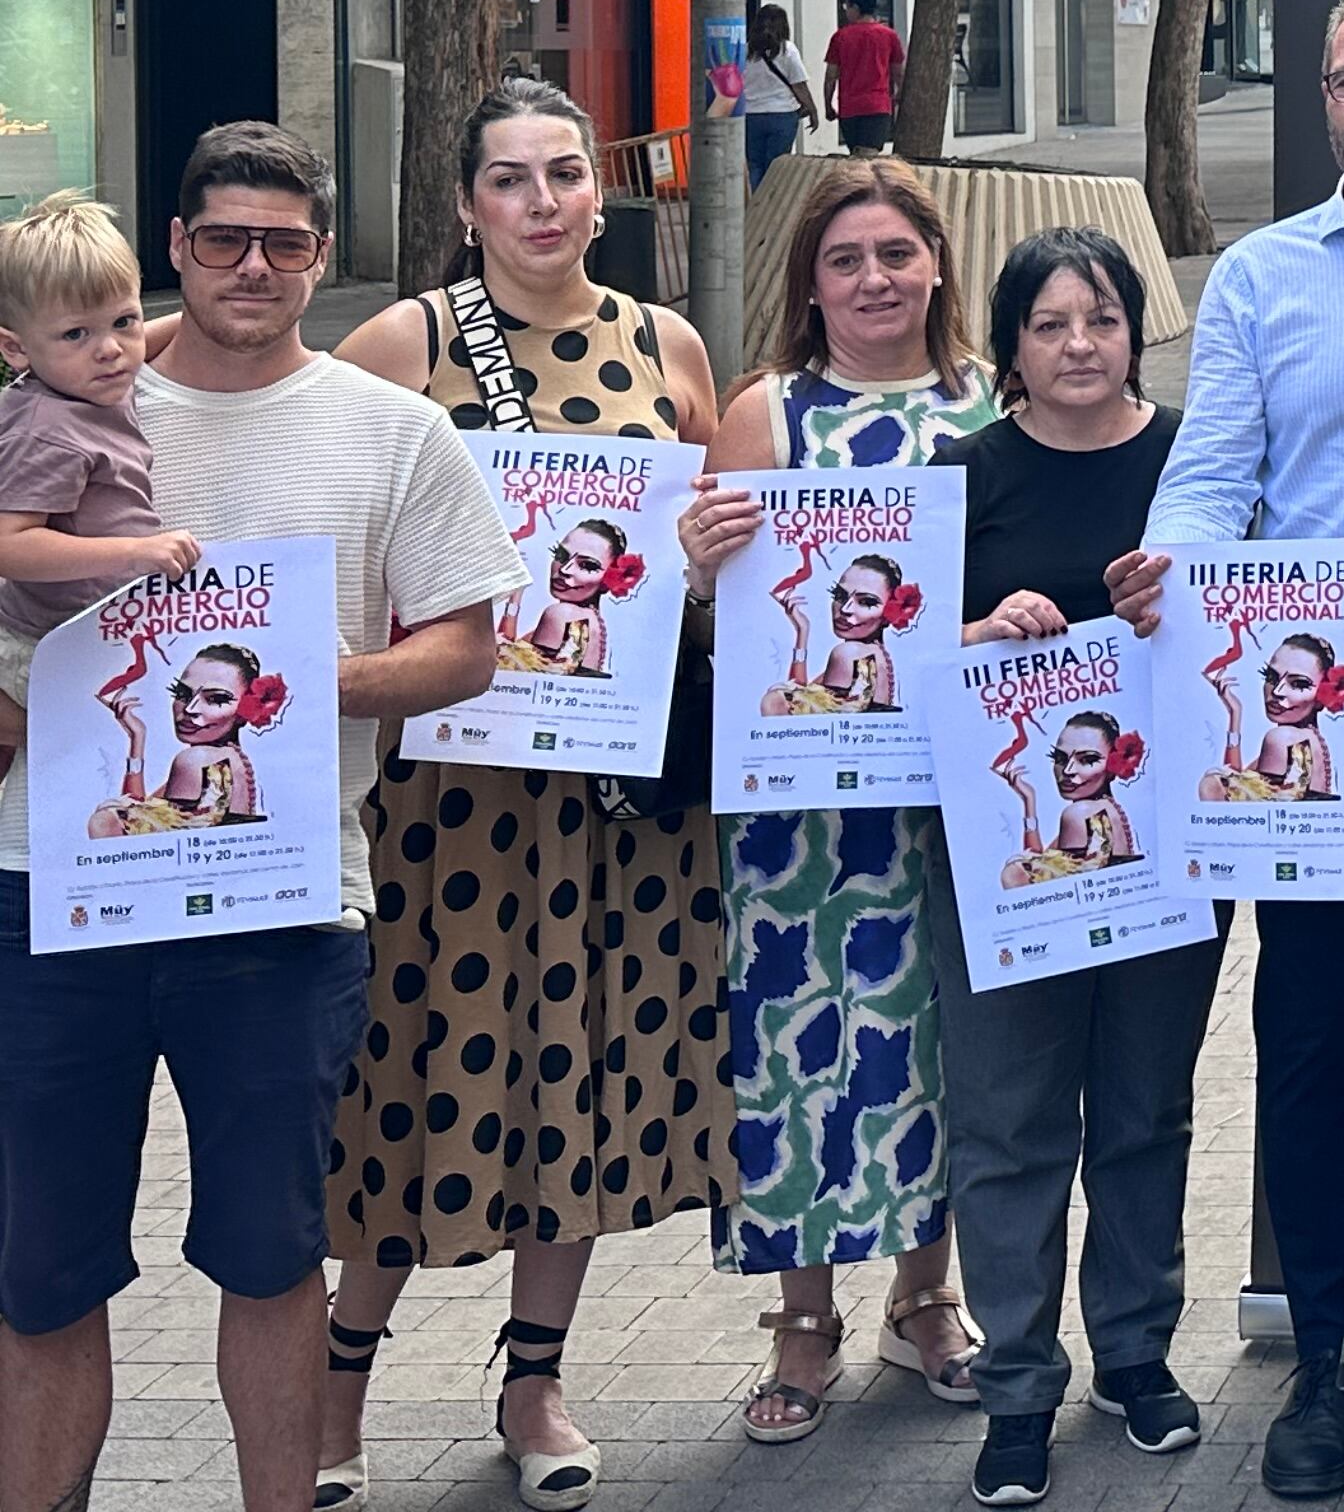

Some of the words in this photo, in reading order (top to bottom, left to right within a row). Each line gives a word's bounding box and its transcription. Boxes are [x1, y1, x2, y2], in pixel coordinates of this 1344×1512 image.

[492, 446, 521, 467] III
[530, 450, 611, 474] FERIA
[619, 456, 654, 478] DE
[504, 467, 646, 496] COMERCIO
[503, 487, 642, 512] TRADICIONAL
[798, 489, 876, 508] FERIA
[886, 488, 917, 507] DE
[775, 508, 912, 528] COMERCIO
[774, 528, 912, 544] TRADICIONAL
[237, 563, 275, 588] DE
[1190, 564, 1215, 586] III
[1227, 562, 1306, 584] FERIA
[1203, 583, 1344, 605] COMERCIO
[98, 587, 270, 622] COMERCIO
[1204, 605, 1344, 623] TRADICIONAL
[98, 611, 271, 640] TRADICIONAL
[963, 664, 991, 689] III
[1000, 645, 1080, 681] FERIA
[1087, 636, 1121, 662] DE
[542, 681, 554, 691] 18
[980, 657, 1120, 704] COMERCIO
[540, 695, 551, 704] 19
[554, 697, 562, 706] y
[564, 697, 577, 707] 20
[983, 678, 1123, 720] TRADICIONAL
[752, 729, 765, 739] En
[767, 728, 829, 740] septiembre
[839, 721, 850, 730] 18
[839, 735, 849, 744] 19
[852, 736, 859, 745] y
[861, 733, 874, 744] 20
[1190, 814, 1203, 824] En
[1205, 816, 1266, 826] septiembre
[1276, 809, 1287, 819] 18
[1276, 824, 1287, 834] 19
[1289, 826, 1296, 835] y
[1298, 823, 1312, 834] 20
[186, 836, 201, 847] 18
[76, 855, 92, 866] En
[96, 848, 175, 865] septiembre
[186, 852, 200, 863] 19
[204, 853, 212, 864] y
[216, 849, 231, 860] 20
[1082, 879, 1094, 889] 18
[999, 902, 1012, 912] En
[1014, 891, 1074, 910] septiembre
[1085, 892, 1096, 903] 19
[1098, 892, 1105, 901] y
[1107, 887, 1120, 898] 20
